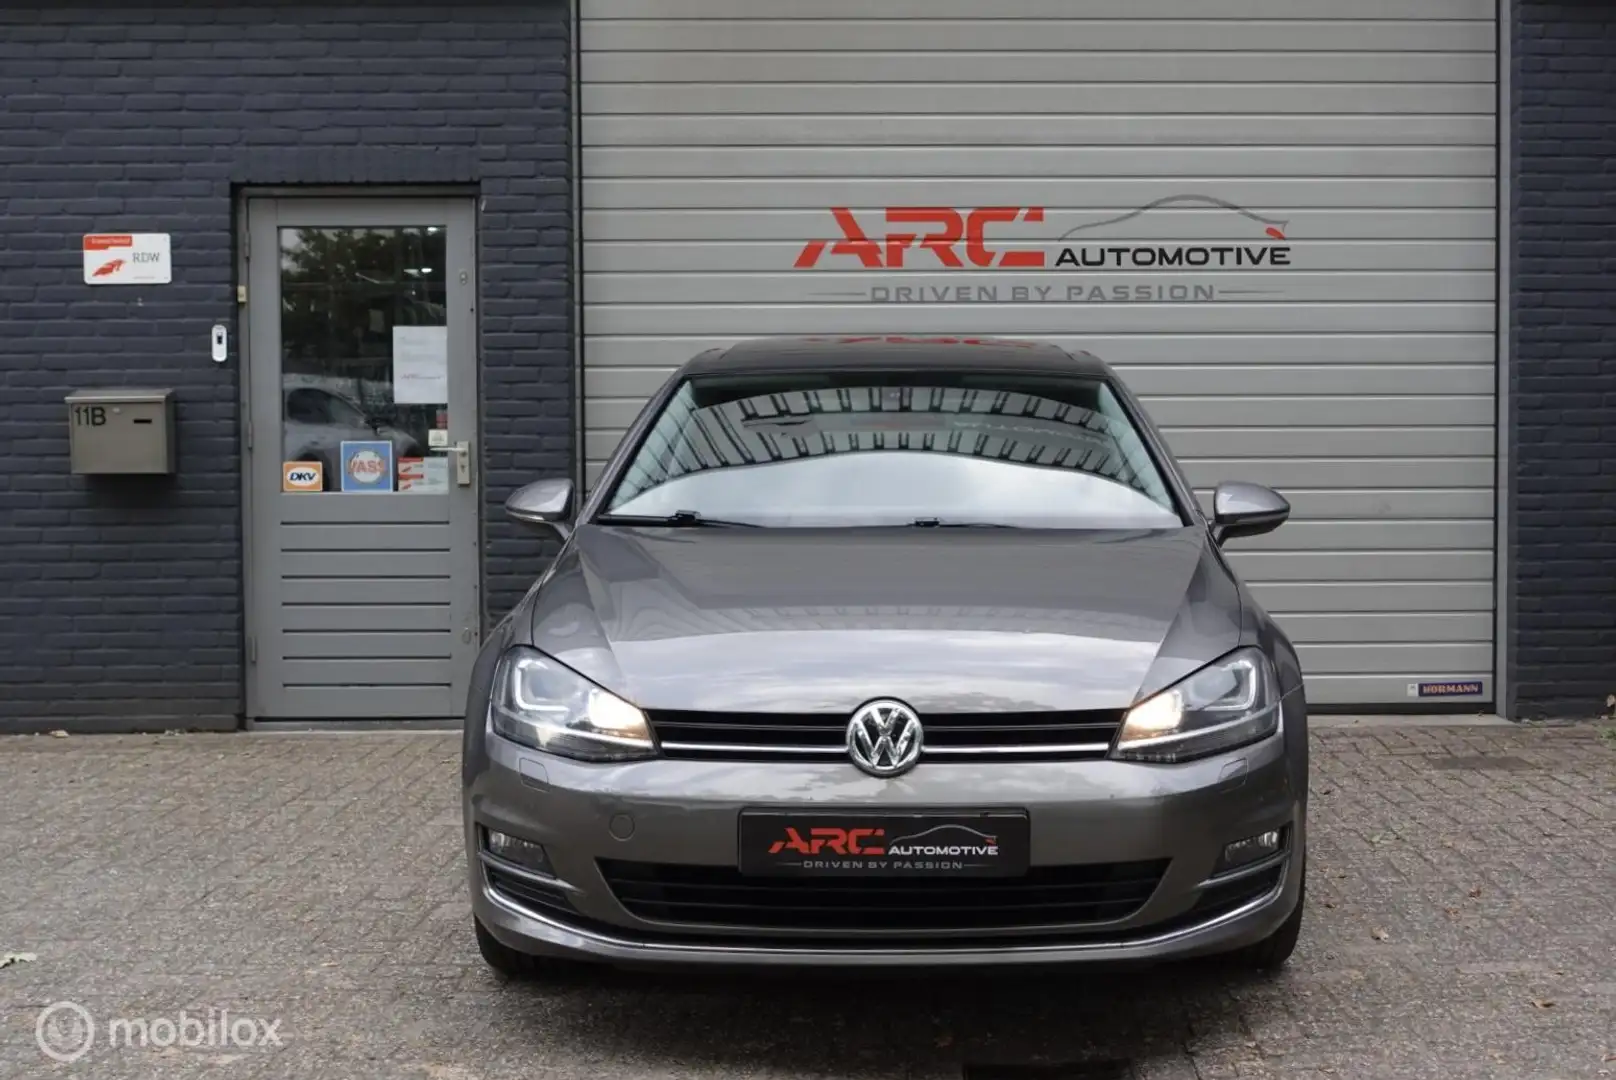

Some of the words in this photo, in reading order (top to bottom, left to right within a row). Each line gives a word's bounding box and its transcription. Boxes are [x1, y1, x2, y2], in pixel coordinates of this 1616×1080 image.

[793, 207, 1045, 268] ARC
[1055, 247, 1291, 267] AUTOMOTIVE
[132, 252, 160, 263] RDW
[871, 286, 998, 301] DRIVEN
[1011, 286, 1051, 300] BY
[1066, 284, 1214, 301] PASSION
[74, 406, 107, 426] 11B
[289, 472, 316, 481] DKV
[768, 827, 885, 855] ARC
[888, 845, 999, 856] AUTOMOTIVE
[803, 860, 864, 869] DRIVEN
[868, 861, 888, 869] BY
[893, 861, 963, 869] PASSION
